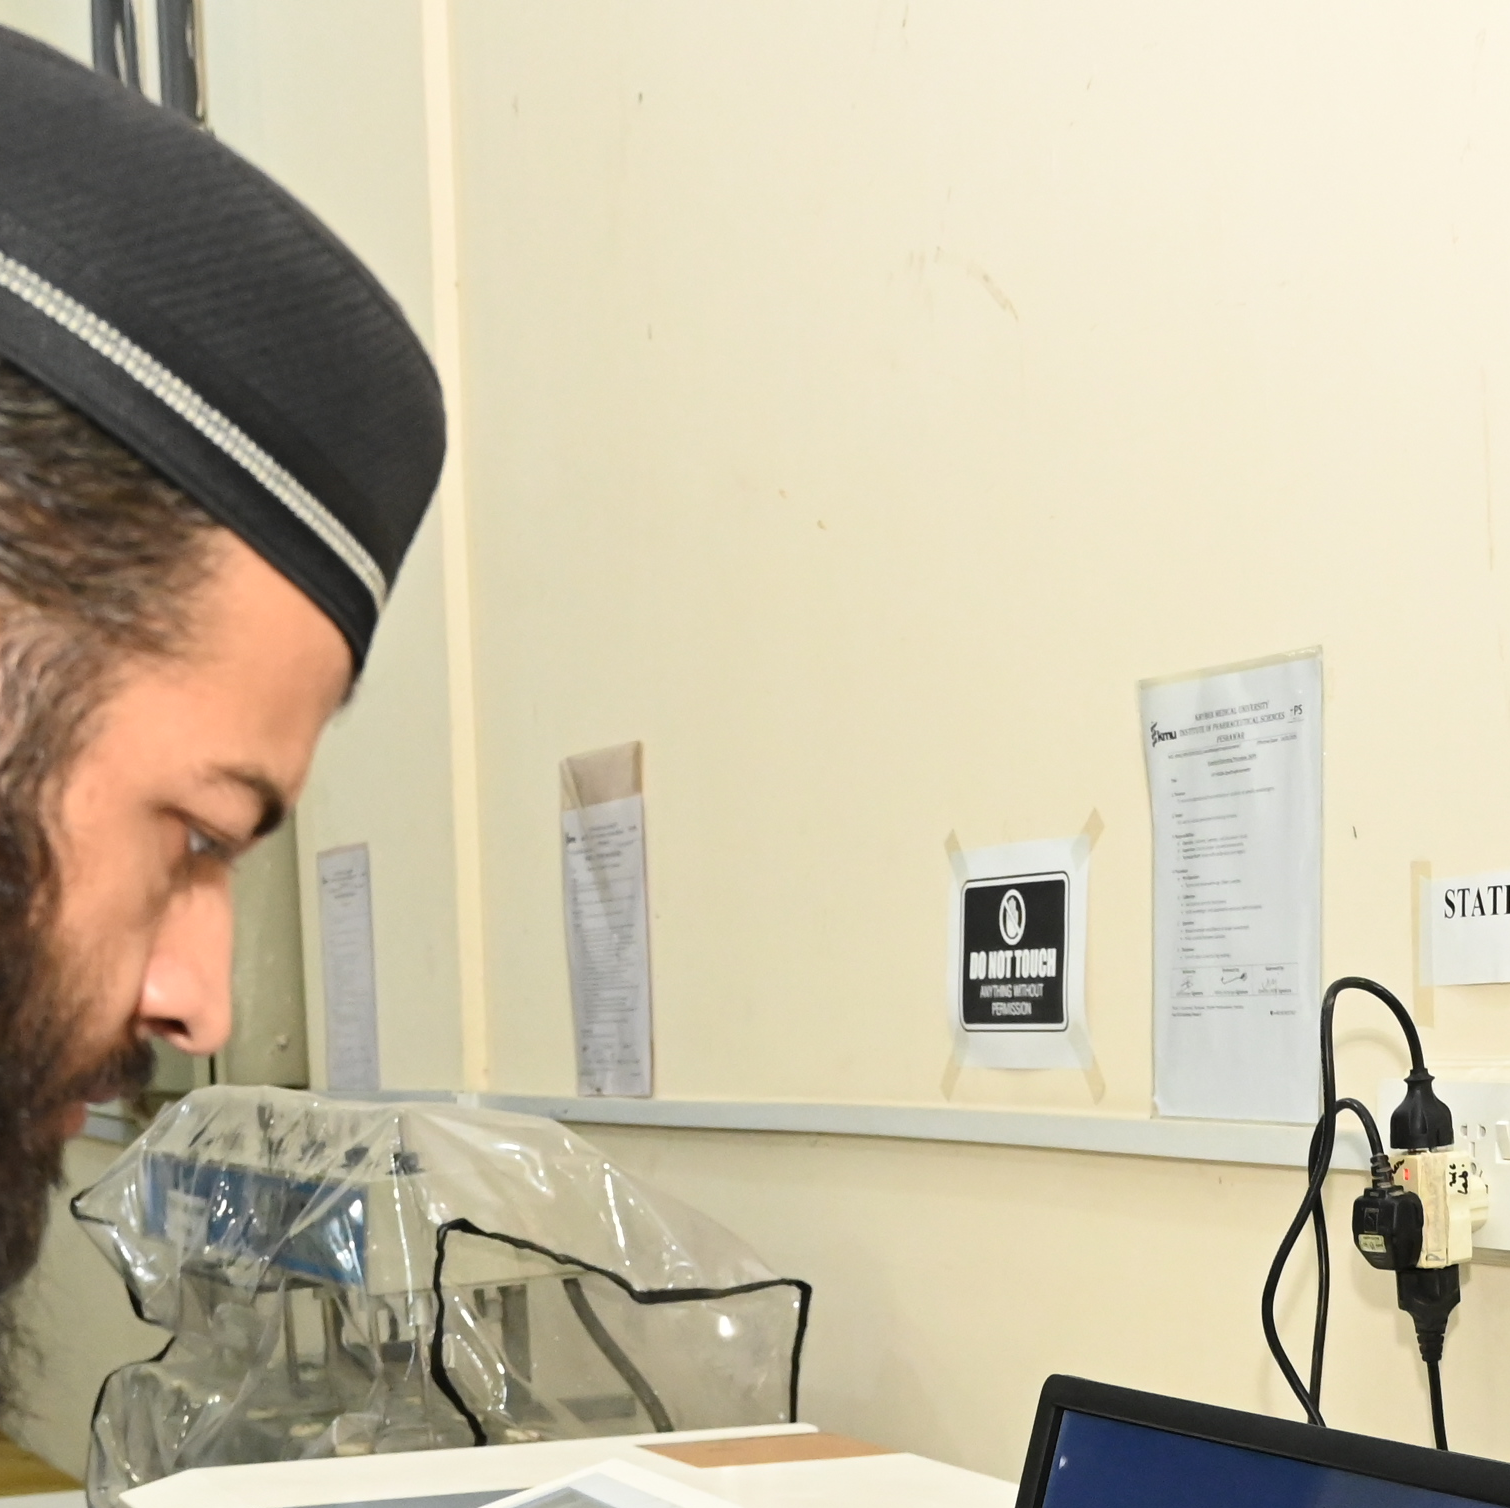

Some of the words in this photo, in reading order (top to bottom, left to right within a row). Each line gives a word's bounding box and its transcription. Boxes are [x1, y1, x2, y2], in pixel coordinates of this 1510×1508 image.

[969, 951, 987, 980] DO
[988, 950, 1013, 979] NOT
[1014, 948, 1057, 978] TOUCH
[979, 984, 1012, 998] ANYTHING
[1013, 983, 1044, 997] WITHOUT
[992, 1002, 1032, 1016] PERMISSION
